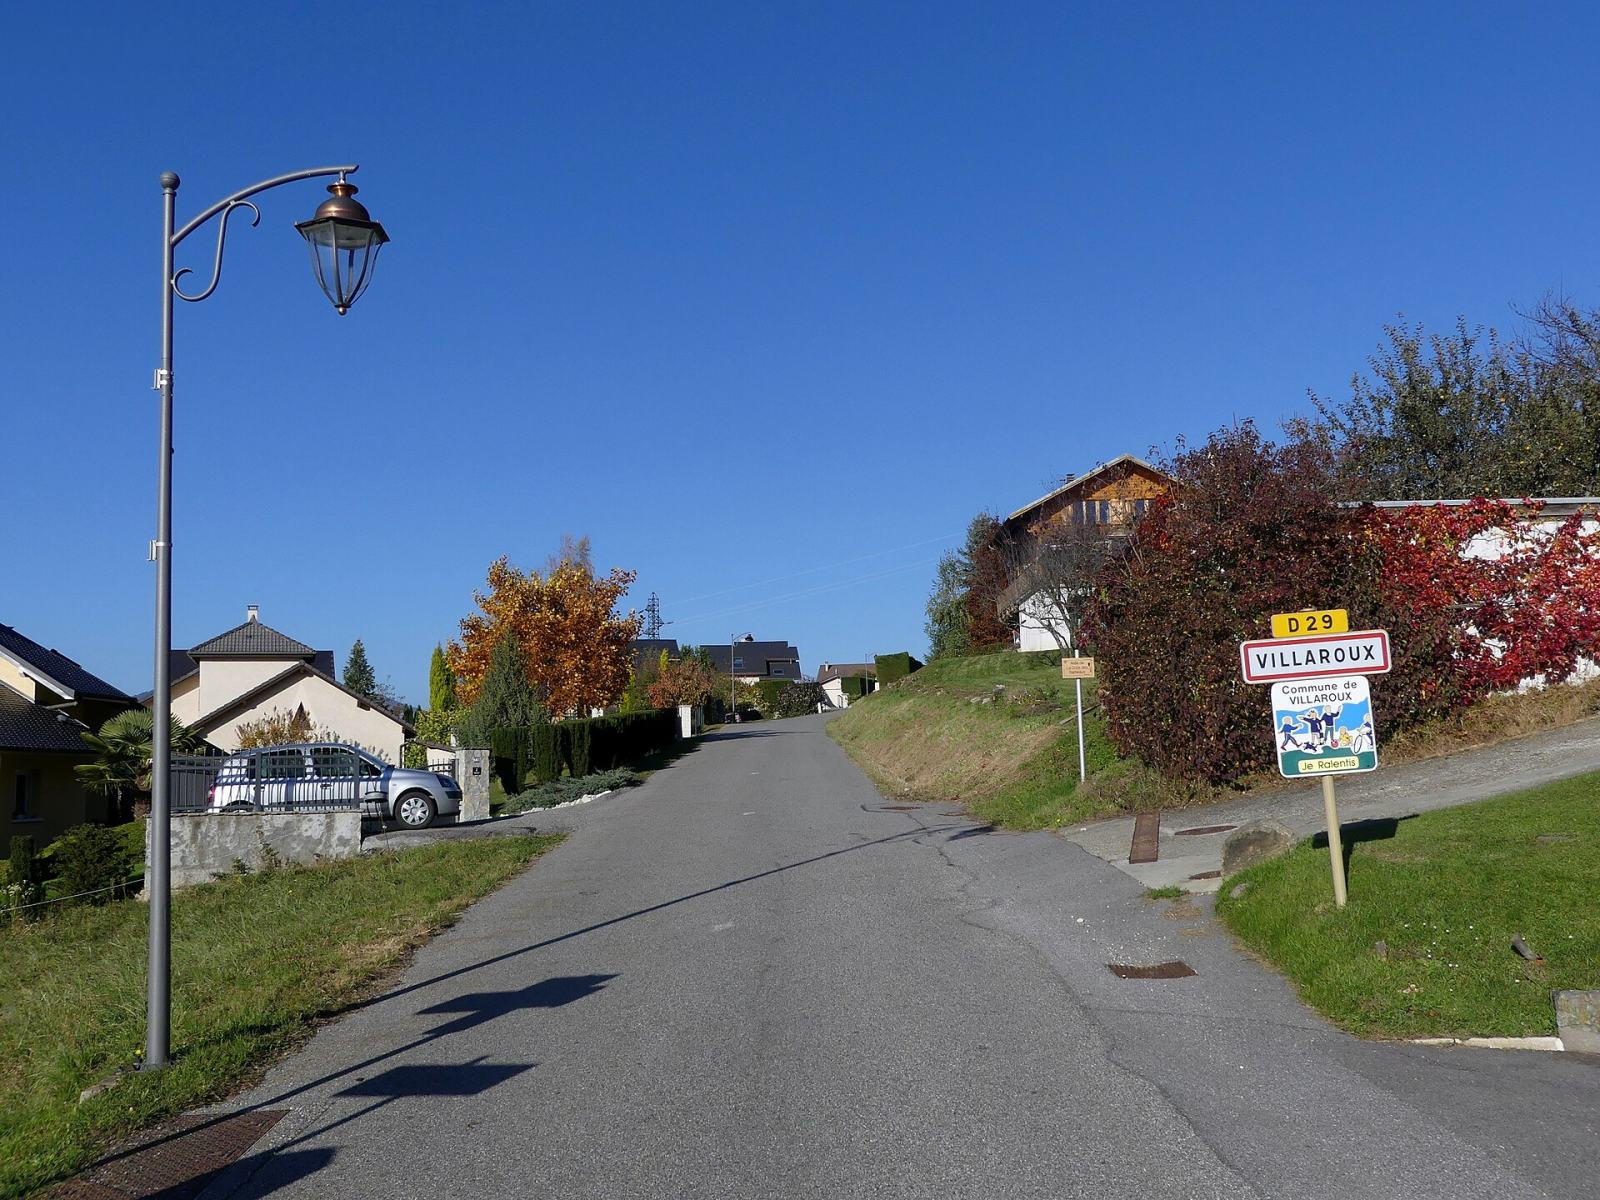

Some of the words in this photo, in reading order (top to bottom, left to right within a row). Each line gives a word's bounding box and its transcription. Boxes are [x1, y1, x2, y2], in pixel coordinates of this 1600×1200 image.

[1256, 644, 1375, 669] VILLAROUX
[1281, 683, 1338, 695] Commune
[1343, 680, 1357, 689] de
[1289, 691, 1352, 705] VILLAROUX
[1302, 762, 1313, 771] Je
[1318, 758, 1356, 770] Ralentis
